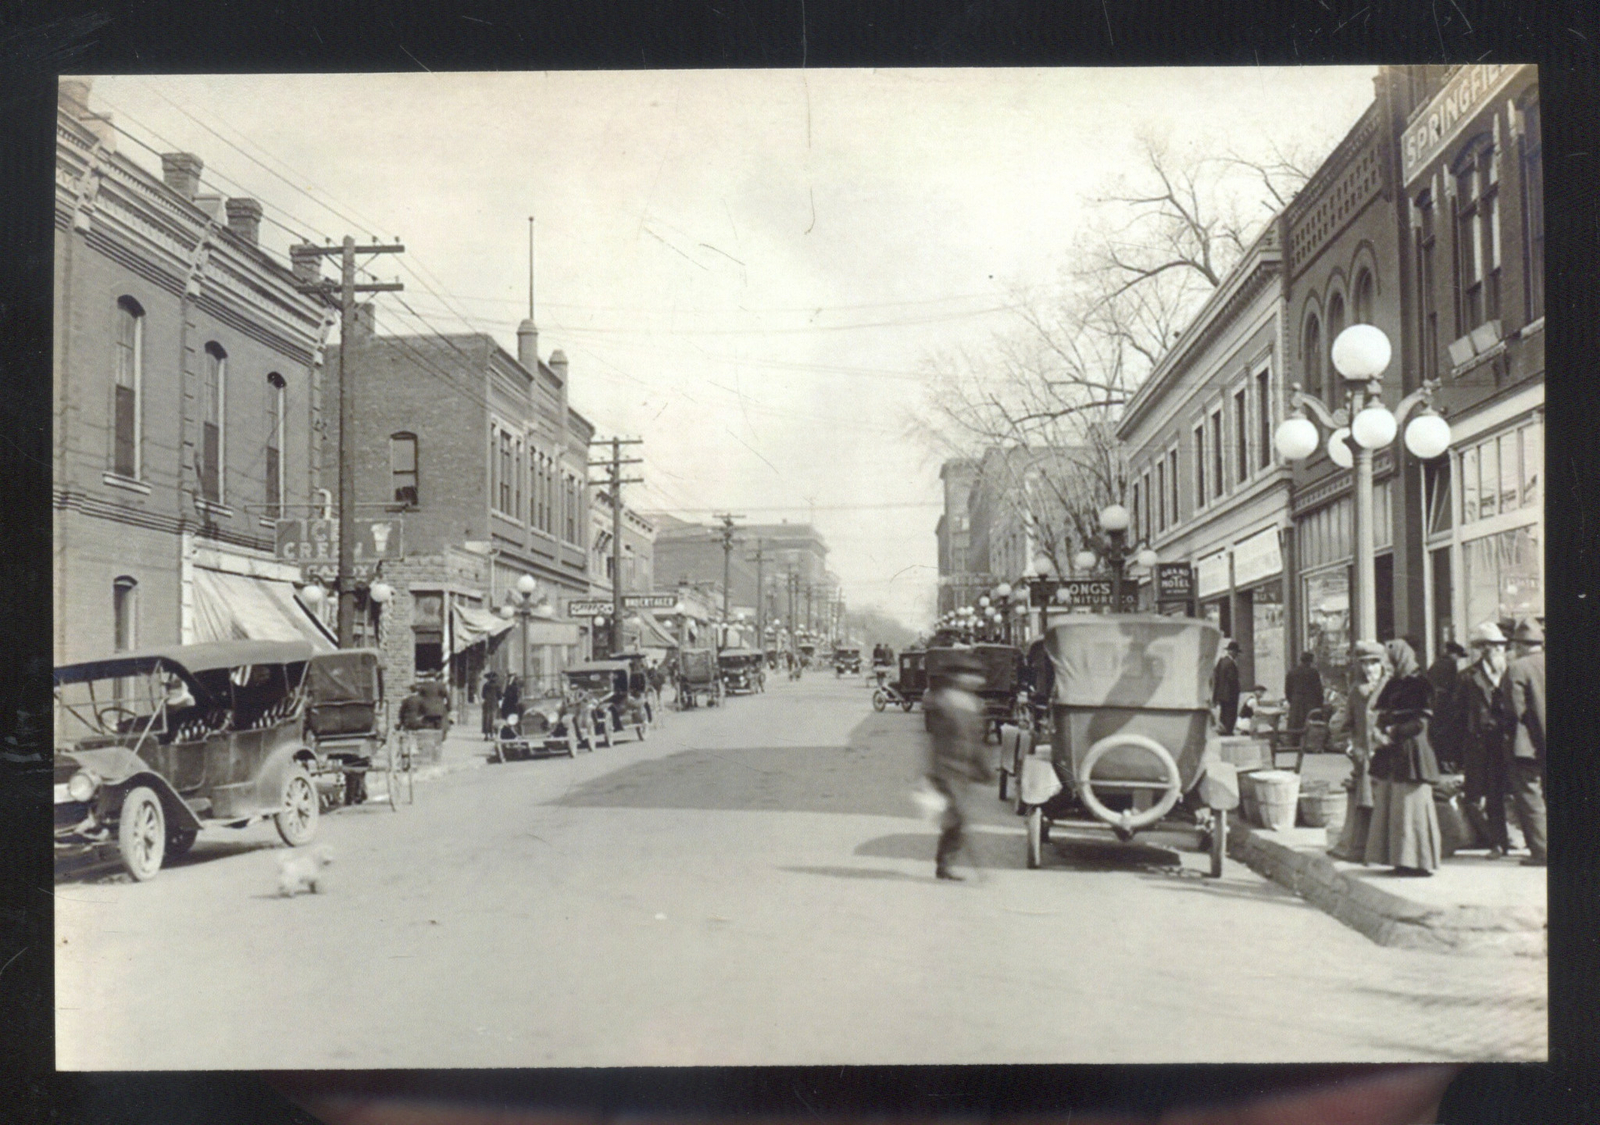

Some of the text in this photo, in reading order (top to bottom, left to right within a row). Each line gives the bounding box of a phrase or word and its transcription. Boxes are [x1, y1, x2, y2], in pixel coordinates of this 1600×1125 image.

[1406, 64, 1508, 169] SPRINGFIE
[300, 520, 340, 541] ICE
[1161, 576, 1190, 588] HOTEL
